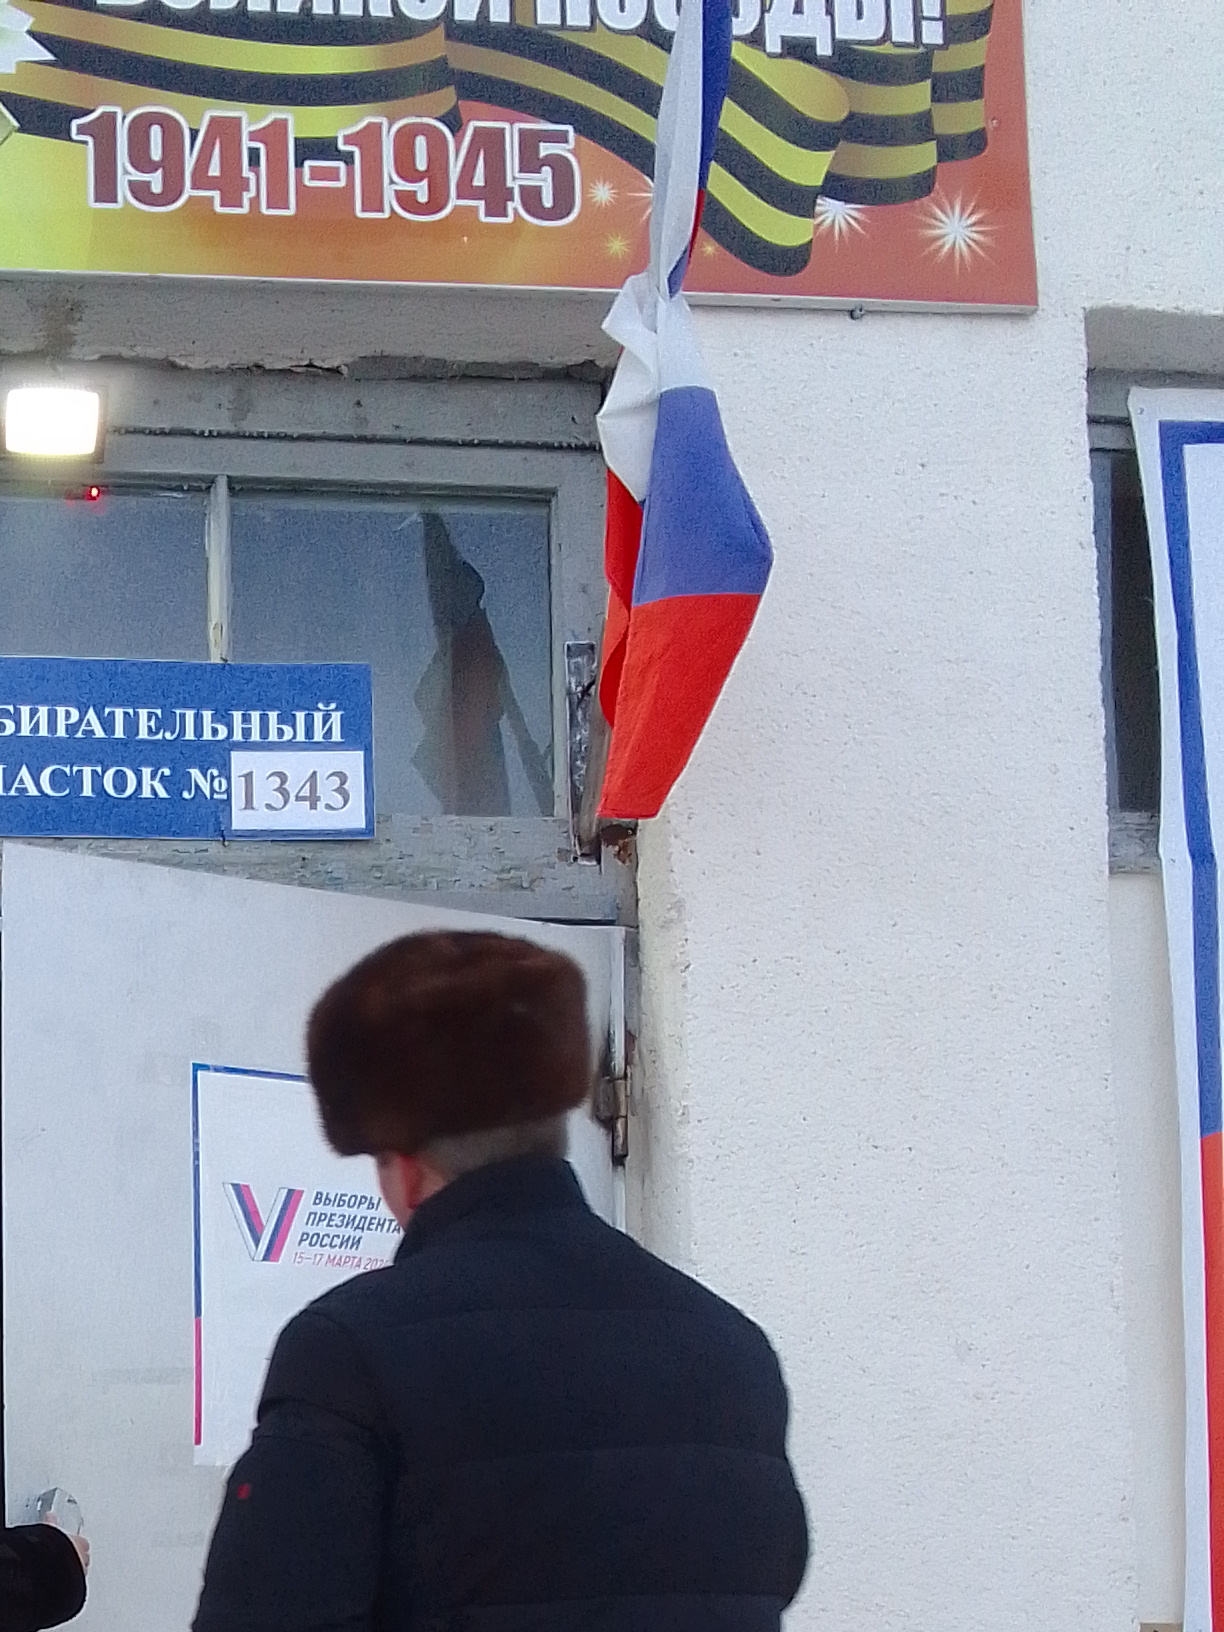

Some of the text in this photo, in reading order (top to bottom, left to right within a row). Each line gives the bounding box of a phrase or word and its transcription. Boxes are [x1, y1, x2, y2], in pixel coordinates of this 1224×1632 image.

[71, 105, 581, 226] 1941-1945
[237, 769, 352, 812] 1343
[312, 1190, 382, 1211] ВЫБОРЫ
[305, 1211, 401, 1234] ПРЕЗИДЕНТА
[297, 1231, 363, 1251] РОССИИ
[325, 1253, 363, 1269] МАРТА
